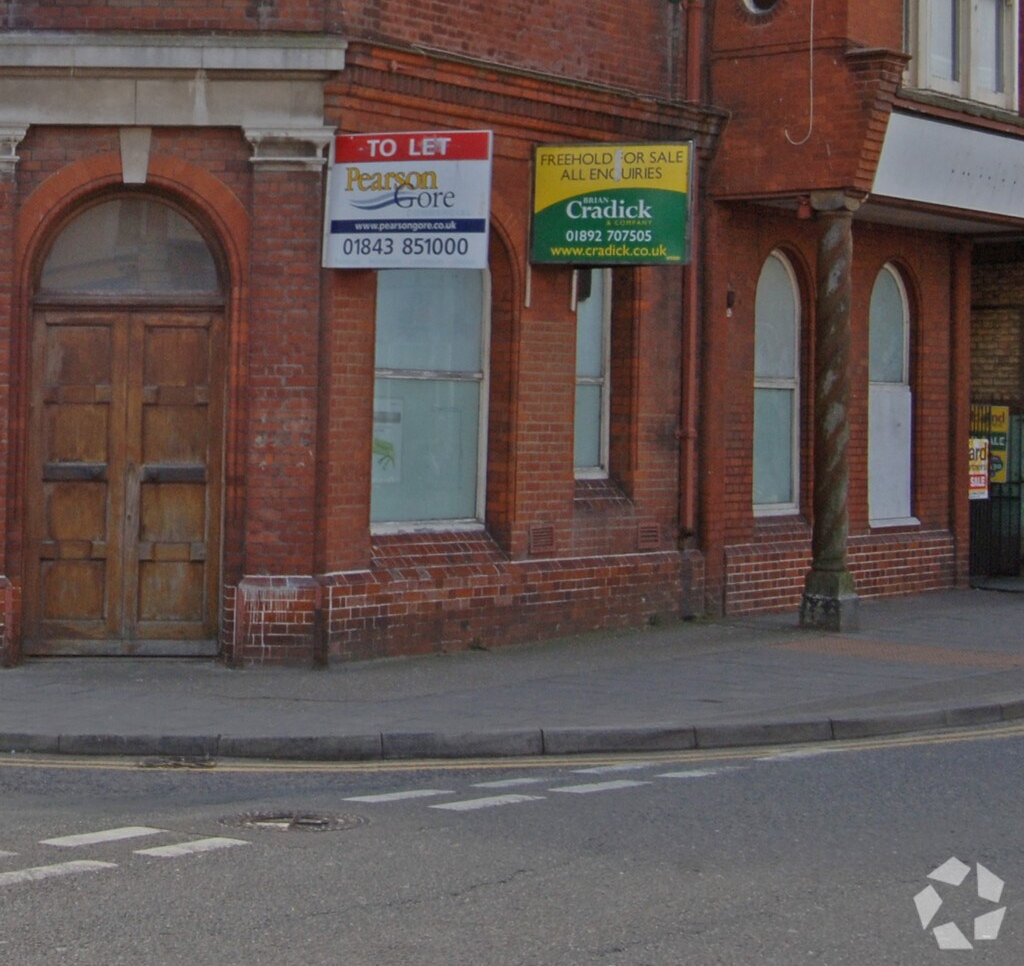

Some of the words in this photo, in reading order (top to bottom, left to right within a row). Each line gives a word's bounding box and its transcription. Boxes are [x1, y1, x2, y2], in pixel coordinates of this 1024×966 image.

[367, 139, 397, 157] TO
[409, 137, 452, 156] LET
[540, 153, 612, 166] FREEHOLD
[620, 152, 645, 164] OR
[649, 151, 683, 164] SALE
[345, 167, 438, 191] Pearson
[560, 169, 585, 181] ALL
[394, 182, 455, 209] Gore
[566, 199, 652, 219] Cradick
[355, 220, 457, 232] www.pearsongore.co.uk
[566, 230, 602, 242] 01892
[607, 229, 652, 242] 707505
[343, 237, 393, 256] 01843
[402, 237, 469, 256] 851000
[550, 244, 667, 257] www.cradick.co.uk
[970, 476, 986, 487] SALE
